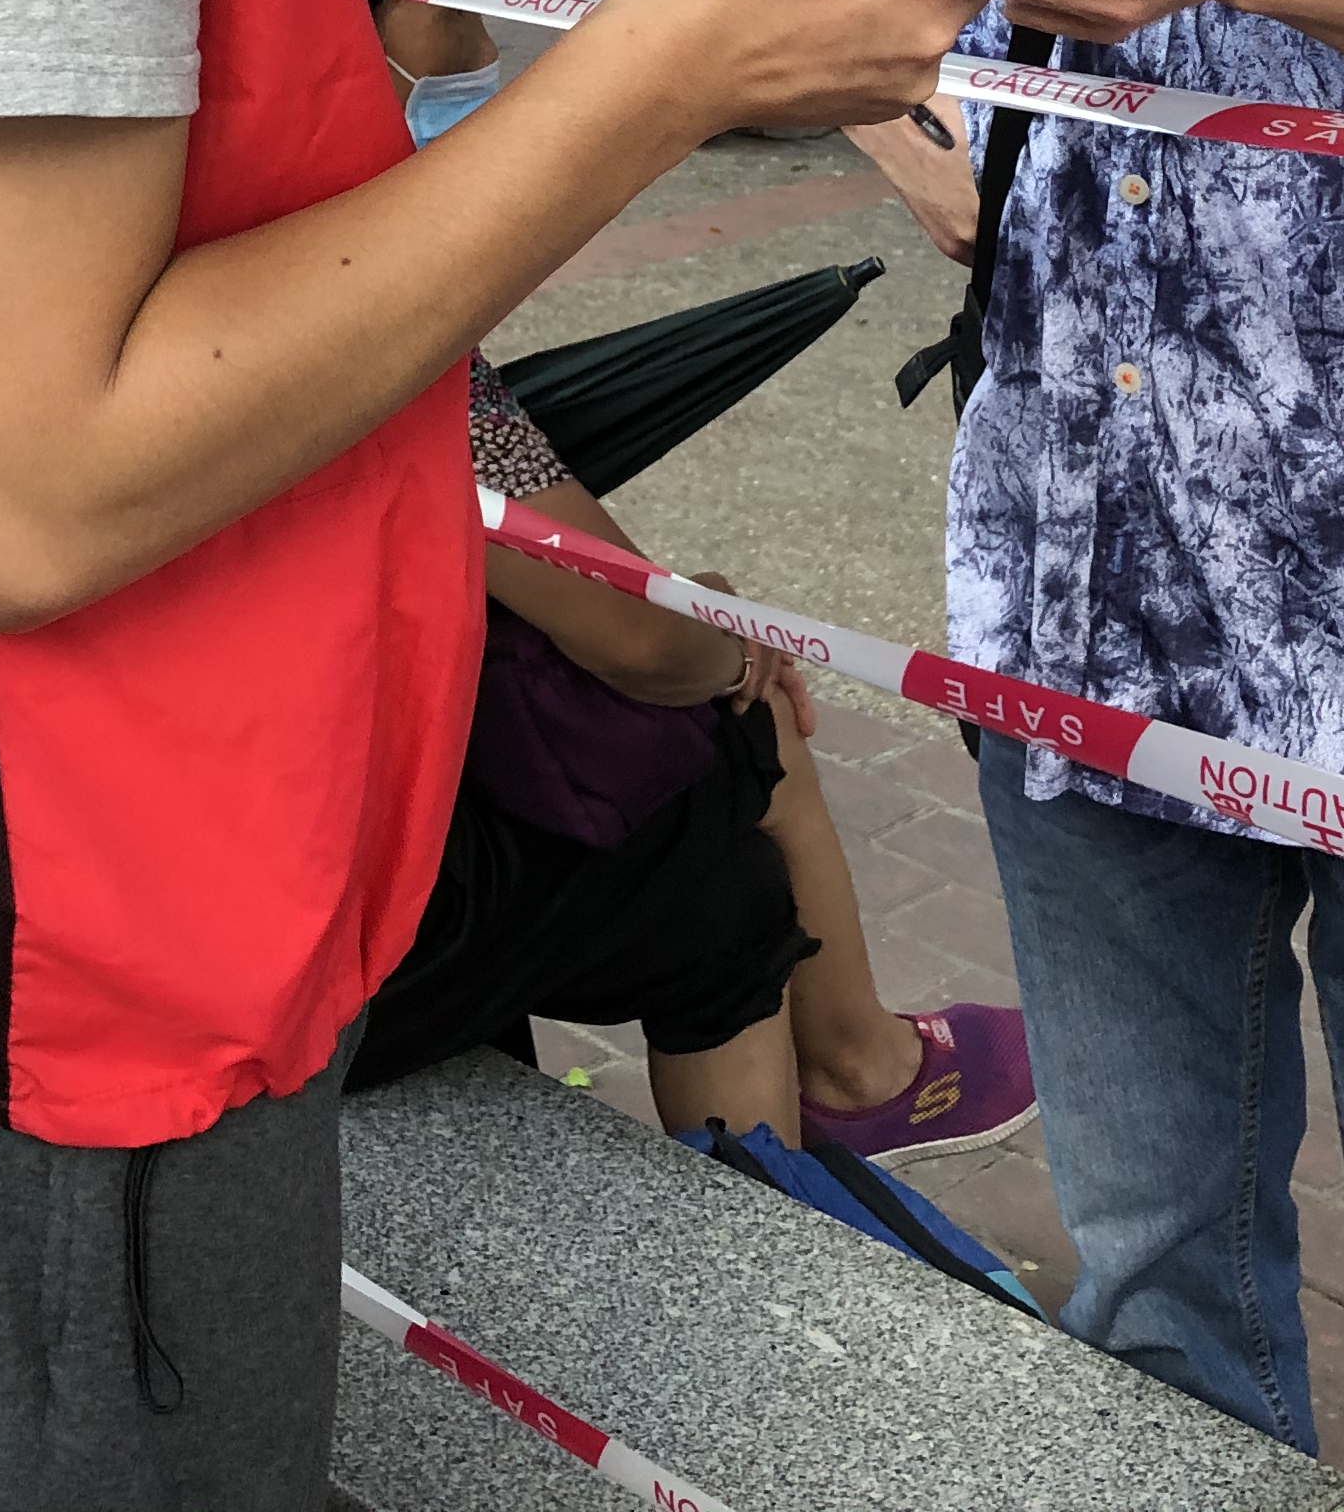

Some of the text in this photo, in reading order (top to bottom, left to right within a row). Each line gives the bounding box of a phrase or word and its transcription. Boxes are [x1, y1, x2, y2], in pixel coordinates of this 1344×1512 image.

[968, 67, 1156, 115] CAUTION
[690, 599, 832, 664] CAUTION
[942, 677, 1085, 746] SAFE
